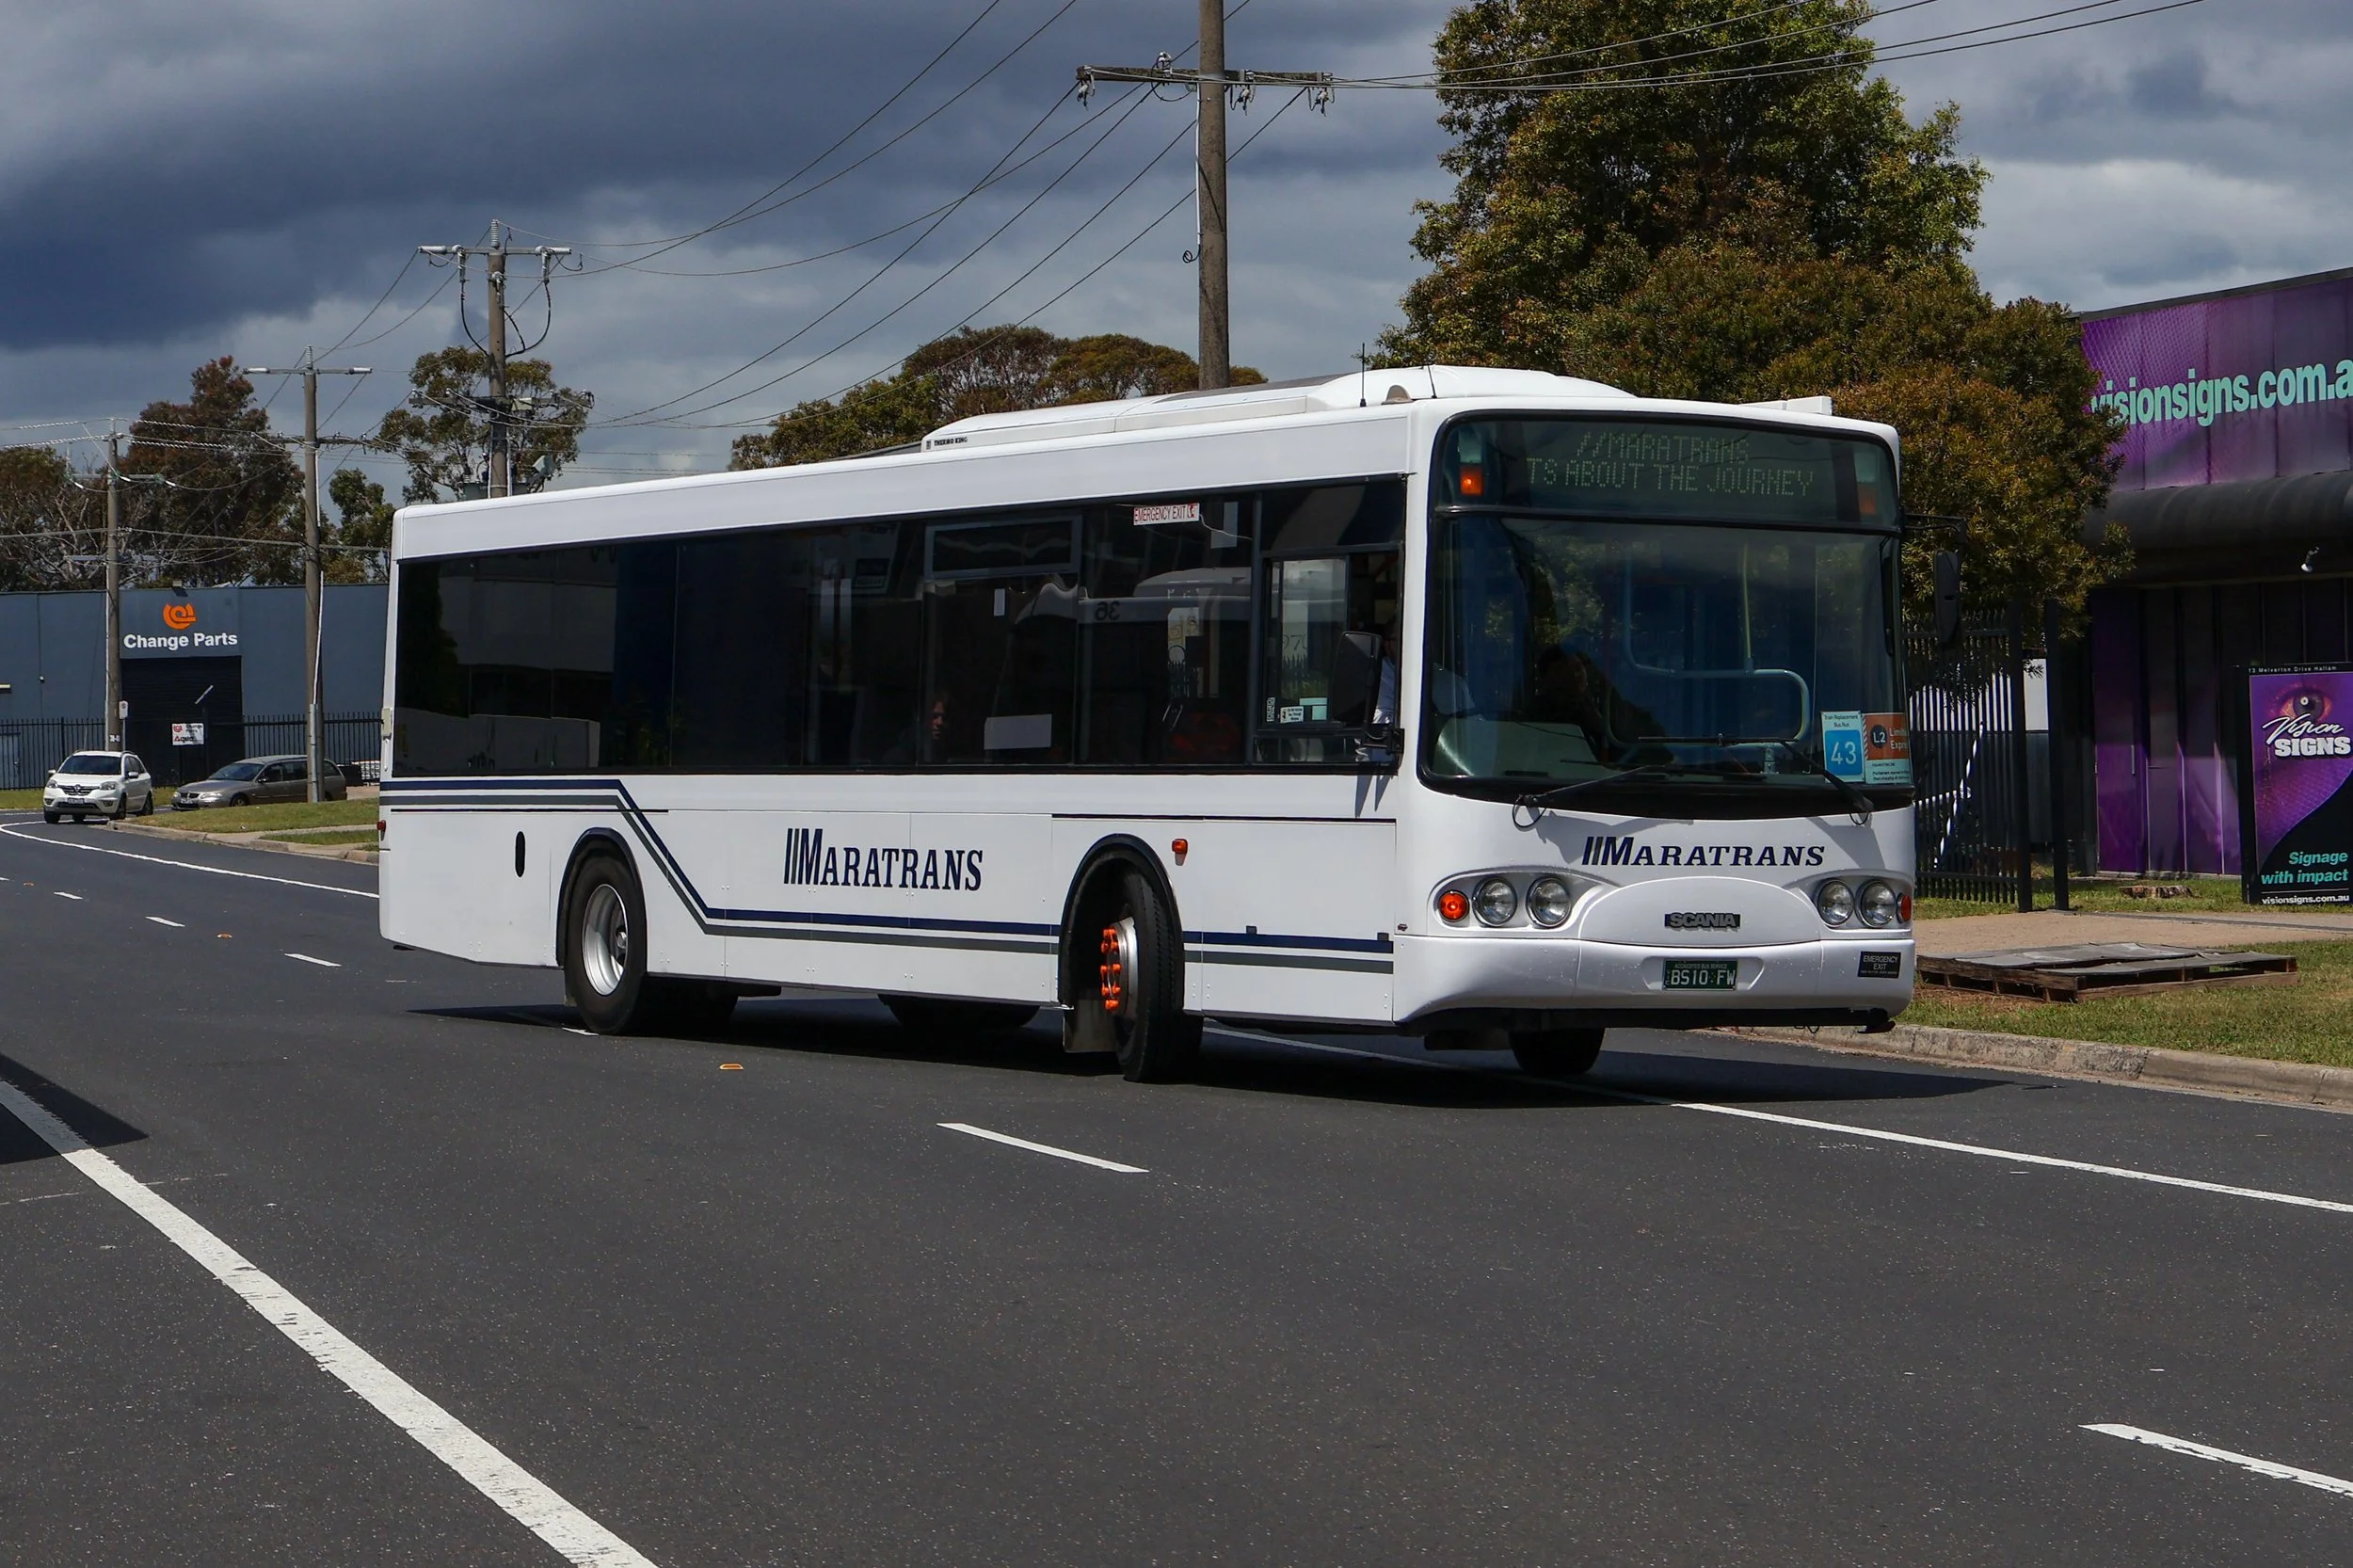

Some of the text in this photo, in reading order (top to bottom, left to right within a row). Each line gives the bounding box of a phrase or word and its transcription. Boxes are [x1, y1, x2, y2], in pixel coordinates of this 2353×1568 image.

[1565, 459, 1645, 489] ABOUT
[1653, 463, 1699, 492] THE
[1707, 467, 1814, 496] JOURNEY
[1134, 505, 1186, 522] EMERGENCY EXIT
[123, 632, 238, 651] Change Parts
[2262, 712, 2345, 745] Vision
[1873, 731, 1886, 744] L2
[1831, 741, 1857, 765] 43
[2274, 736, 2352, 758] SIGNS
[798, 828, 983, 891] MARATRANS
[1601, 836, 1826, 867] MARATRANS
[2288, 851, 2349, 867] Signage
[2261, 869, 2349, 886] with impact
[2262, 895, 2350, 904] visionsigns.com.au
[1669, 912, 1737, 928] SCANIA
[1863, 954, 1898, 963] EMERGENCY
[1671, 969, 1736, 985] BS10 FW
